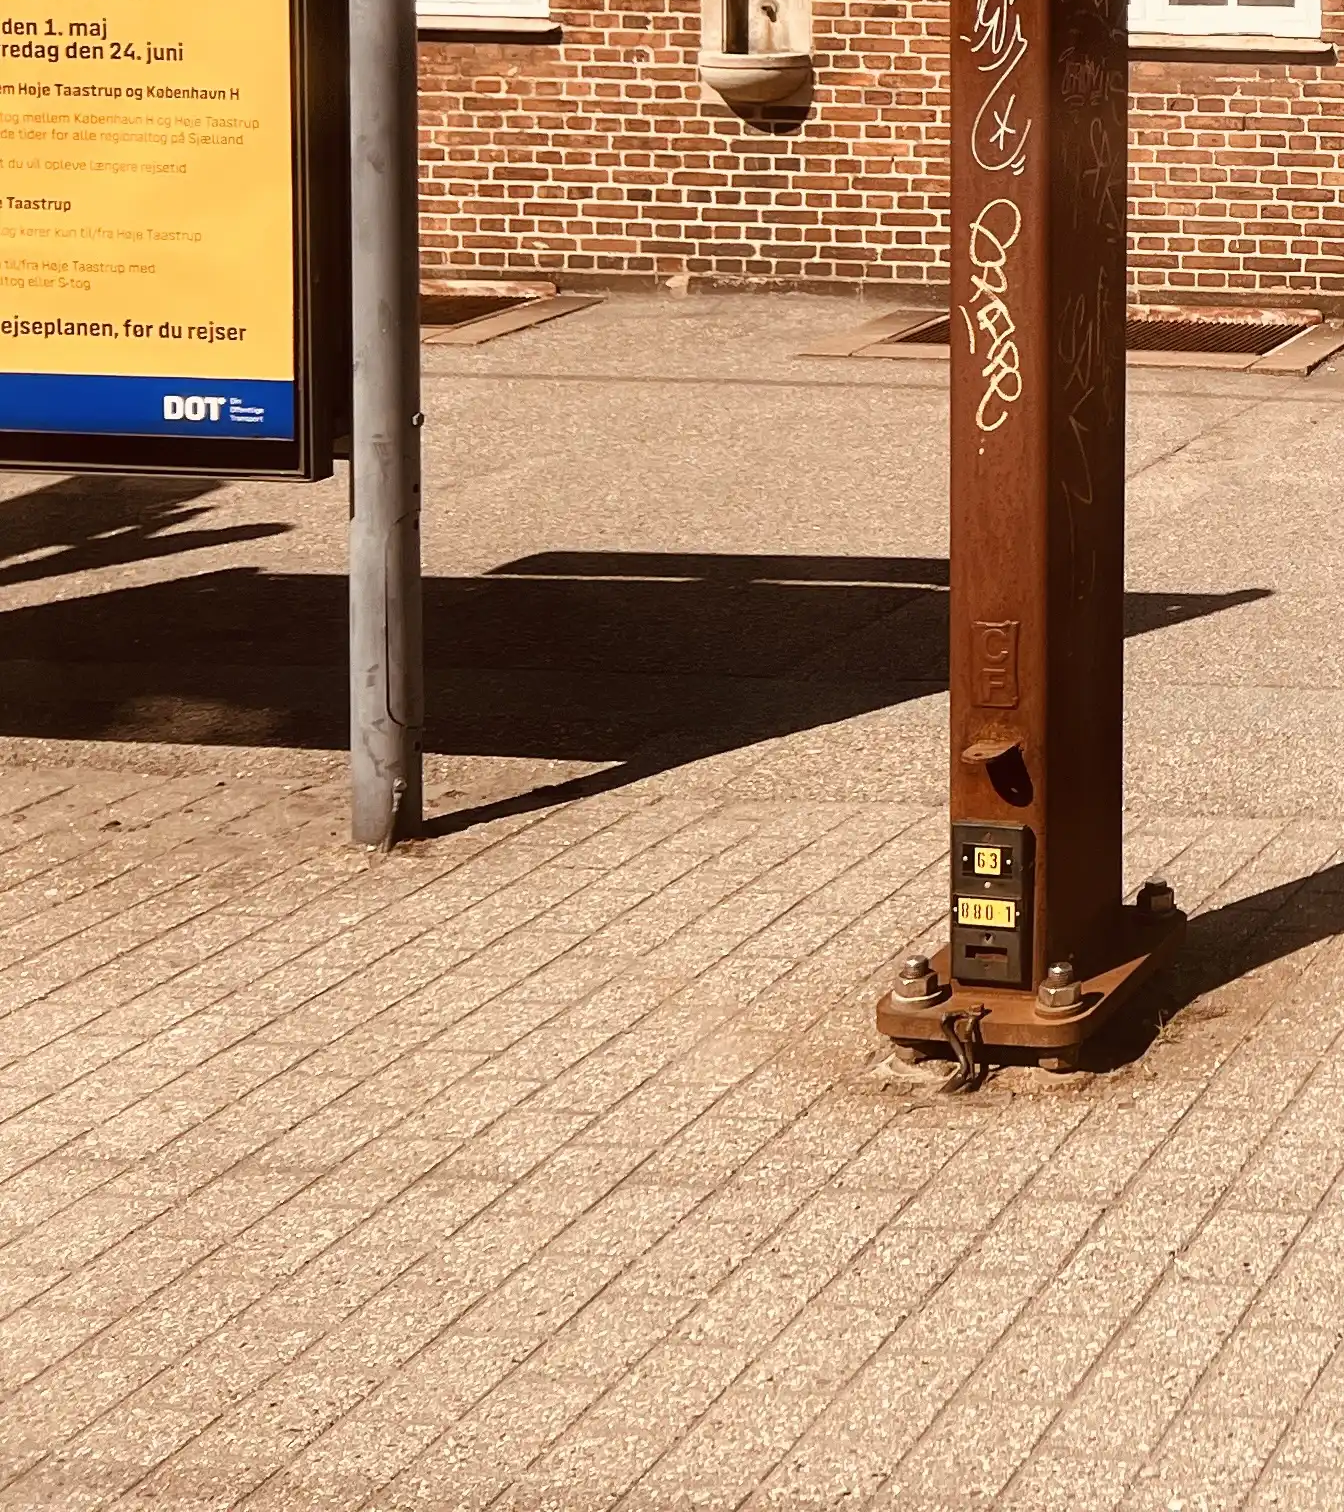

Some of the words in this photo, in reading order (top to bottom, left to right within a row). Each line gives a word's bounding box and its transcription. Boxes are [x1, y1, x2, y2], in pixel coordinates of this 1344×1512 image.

[2, 18, 38, 36] den
[44, 18, 63, 36] 1.
[69, 18, 107, 41] maj
[65, 42, 104, 60] den
[109, 42, 142, 61] 24.
[146, 42, 183, 64] juni
[18, 82, 51, 99] Høje
[54, 83, 123, 100] Taastrup
[125, 87, 143, 100] og
[146, 85, 226, 100] København
[230, 87, 240, 100] H
[22, 112, 71, 124] mellem
[72, 130, 97, 141] alle
[6, 197, 72, 213] Taastrup
[72, 260, 126, 275] Taastrup
[1, 315, 119, 339] ejseplanen,
[123, 318, 154, 338] før
[158, 321, 183, 339] du
[187, 321, 247, 344] rejser
[163, 395, 220, 421] DOT
[977, 852, 998, 870] 63
